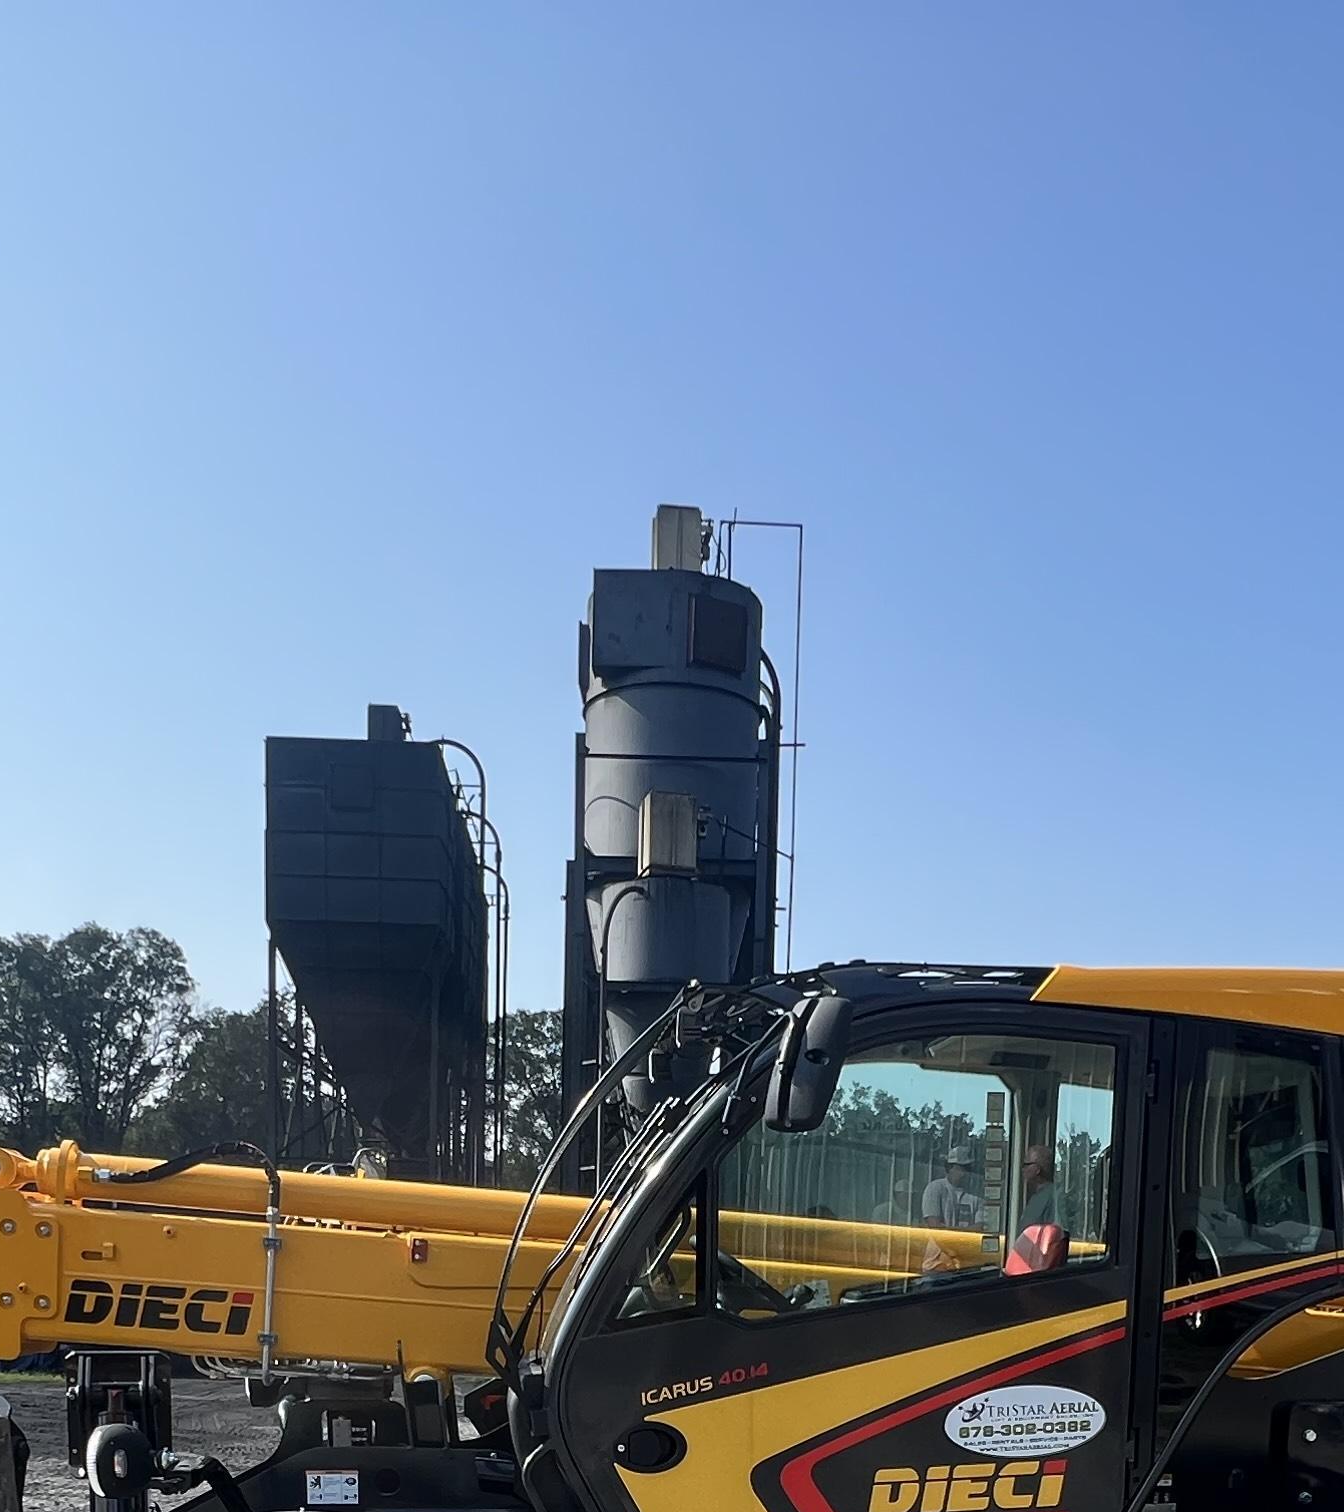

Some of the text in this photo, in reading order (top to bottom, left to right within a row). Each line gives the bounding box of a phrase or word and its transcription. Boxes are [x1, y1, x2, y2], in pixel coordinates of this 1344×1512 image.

[64, 1279, 254, 1336] DIECI
[641, 1376, 713, 1406] ICARUS
[1049, 1401, 1099, 1414] AERIAL
